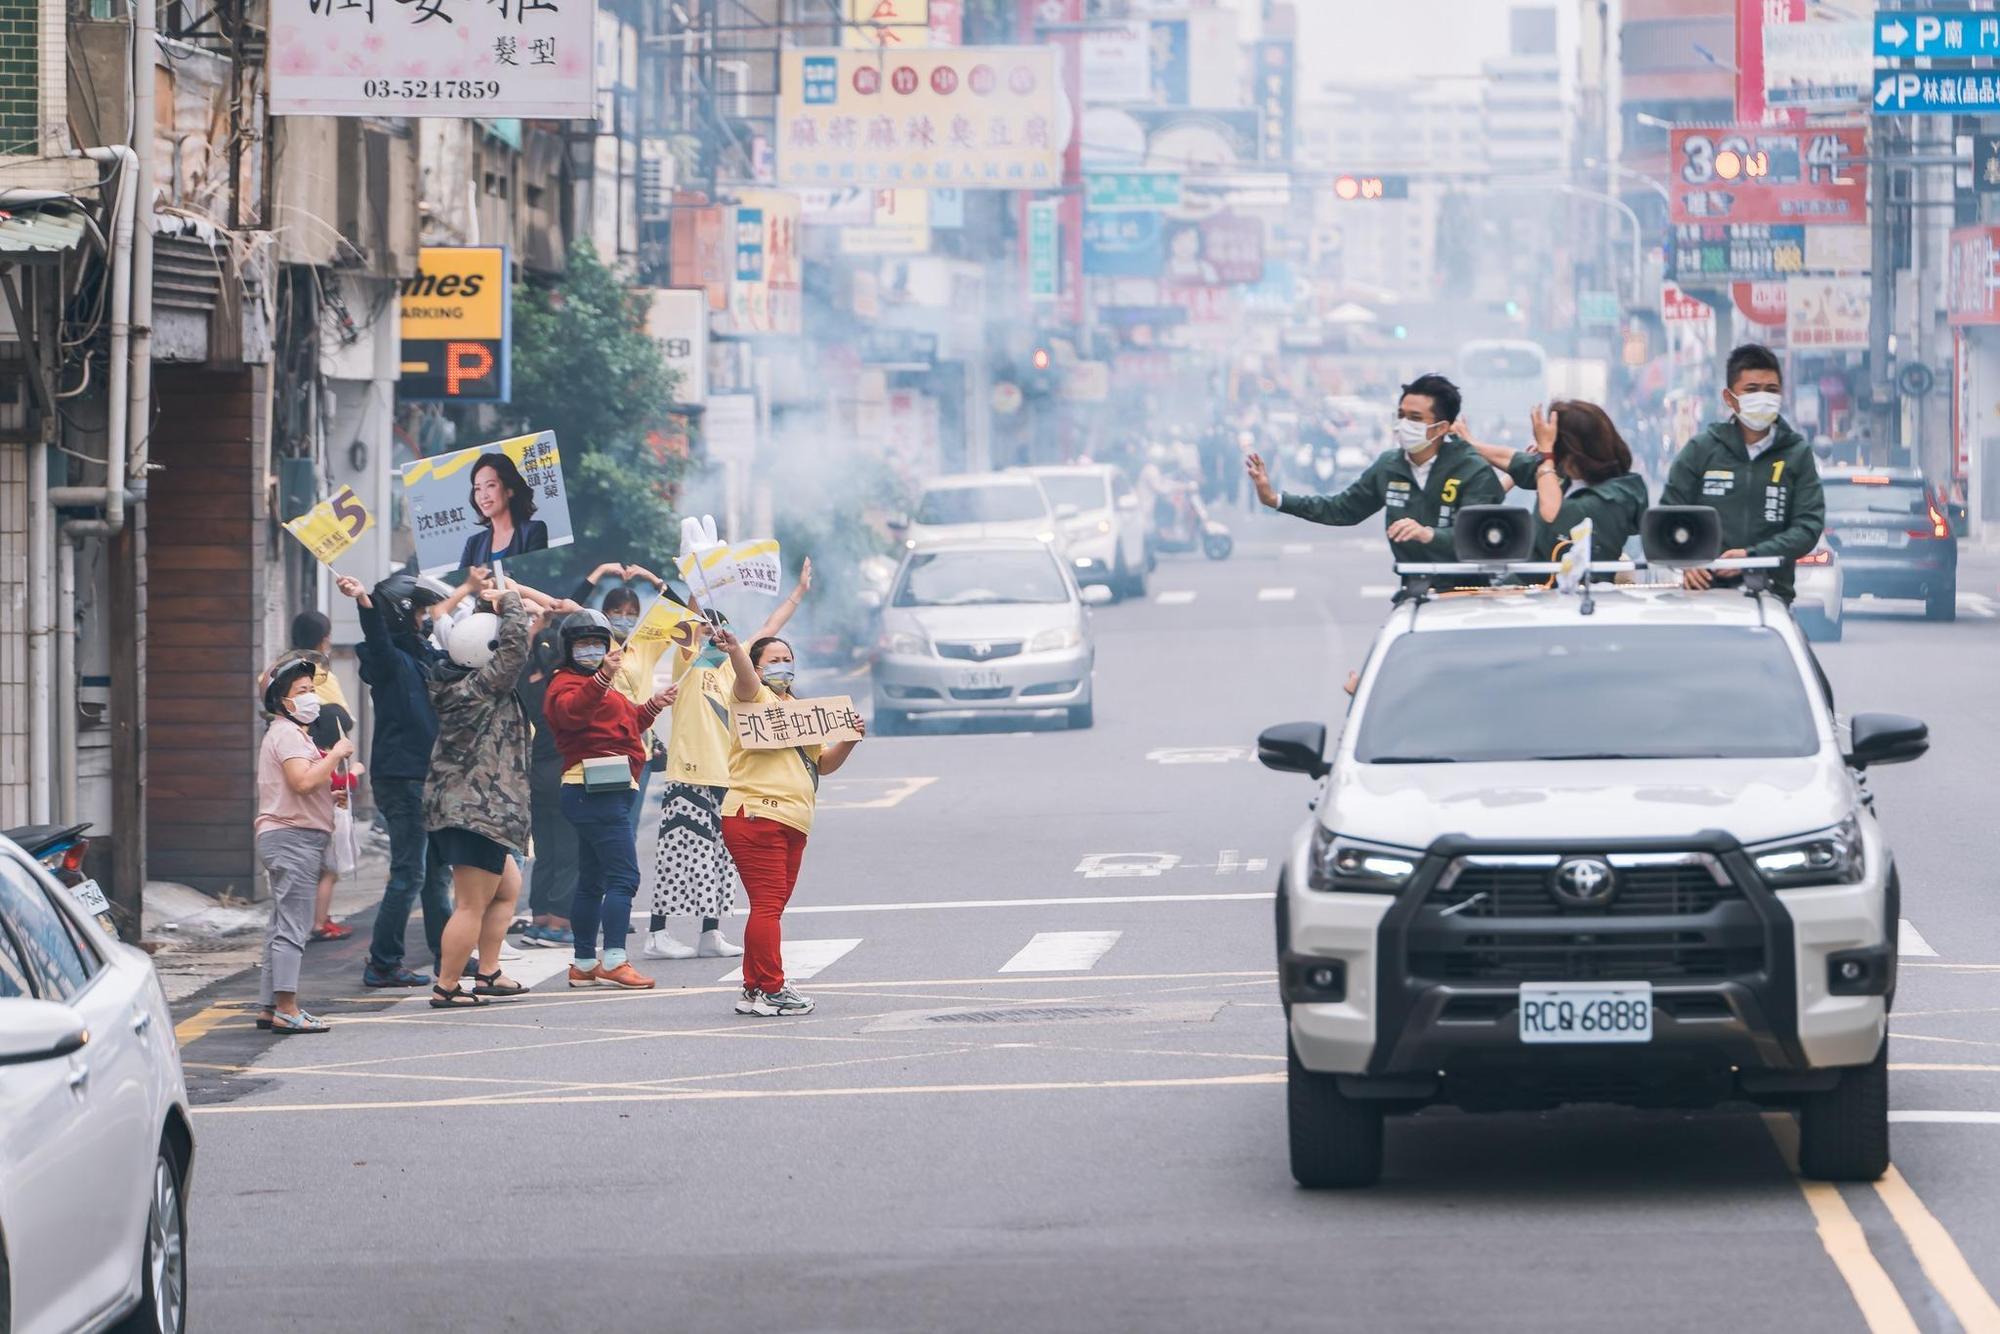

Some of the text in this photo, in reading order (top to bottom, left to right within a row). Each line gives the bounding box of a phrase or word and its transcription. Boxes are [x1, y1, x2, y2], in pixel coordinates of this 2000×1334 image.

[1915, 15, 1942, 52] P
[493, 35, 558, 67] 髮型
[363, 79, 501, 99] 03-5247859
[1898, 74, 2000, 109] P 林森(晶品
[400, 272, 484, 297] mes
[400, 306, 464, 319] ARKING
[447, 342, 494, 395] P
[537, 441, 559, 499] 新竹光榮
[1771, 460, 1785, 483] 1
[1441, 478, 1461, 503] 5
[332, 488, 366, 538] 5
[416, 506, 467, 532] 沈慧虹
[736, 704, 857, 743] 沈慧虹加油
[685, 762, 697, 772] 31
[762, 798, 778, 808] 68
